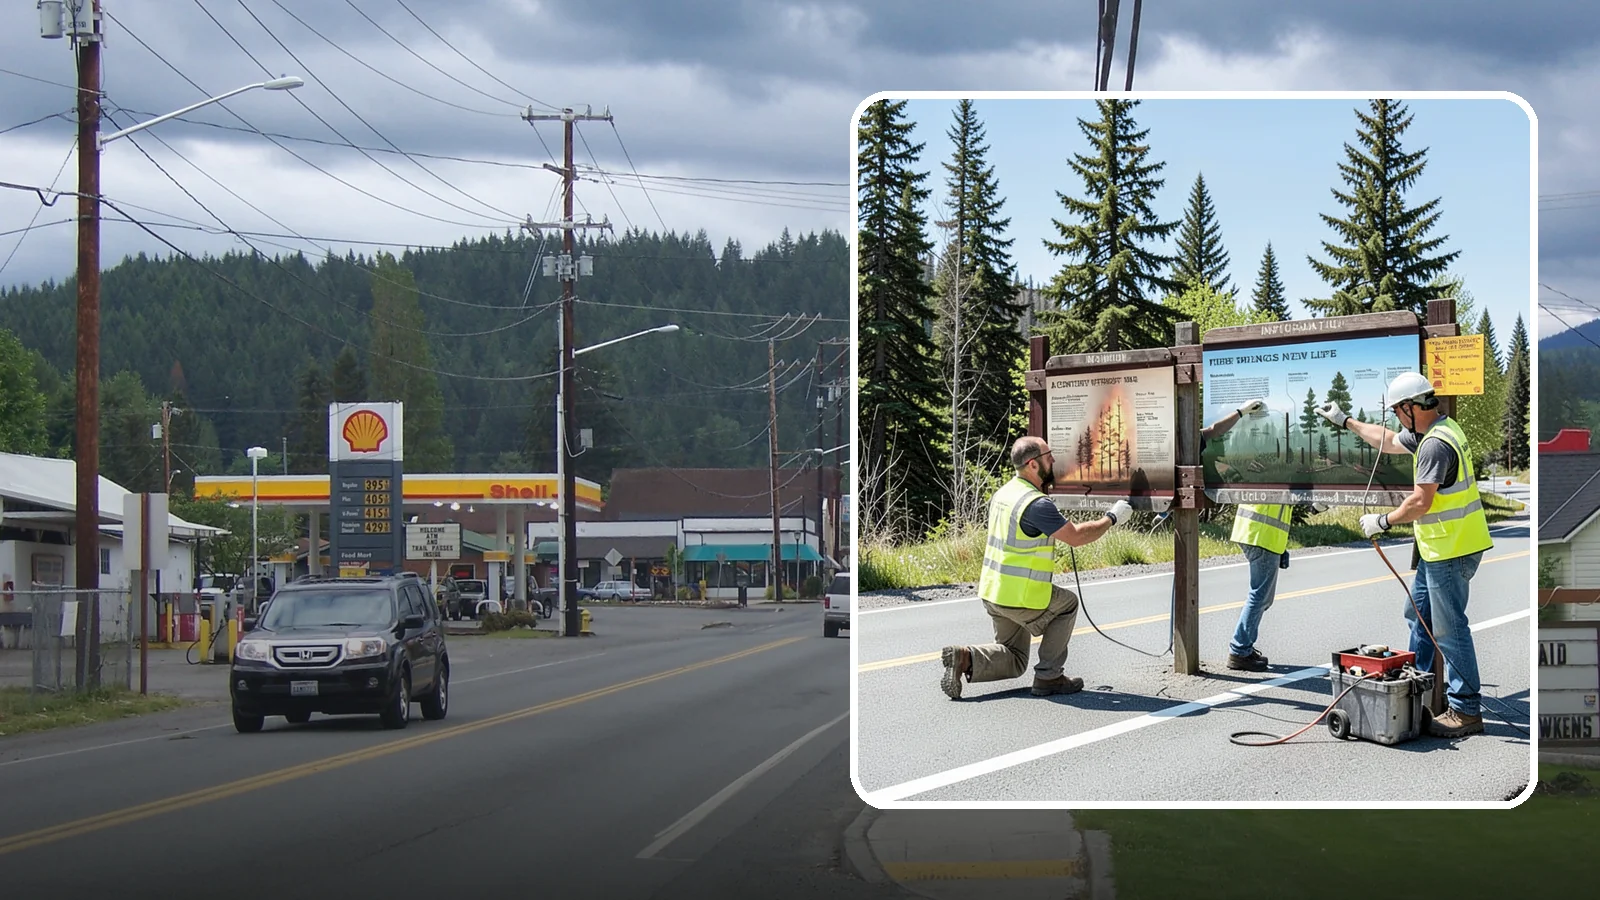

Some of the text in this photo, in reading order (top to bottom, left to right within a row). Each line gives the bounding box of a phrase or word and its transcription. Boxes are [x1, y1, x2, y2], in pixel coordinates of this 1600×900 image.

[366, 480, 383, 490] 395
[490, 484, 547, 499] Shell
[366, 494, 383, 504] 405
[366, 508, 383, 518] 415
[366, 522, 383, 532] 429
[1538, 643, 1567, 665] AID
[1538, 716, 1592, 738] WKENS
